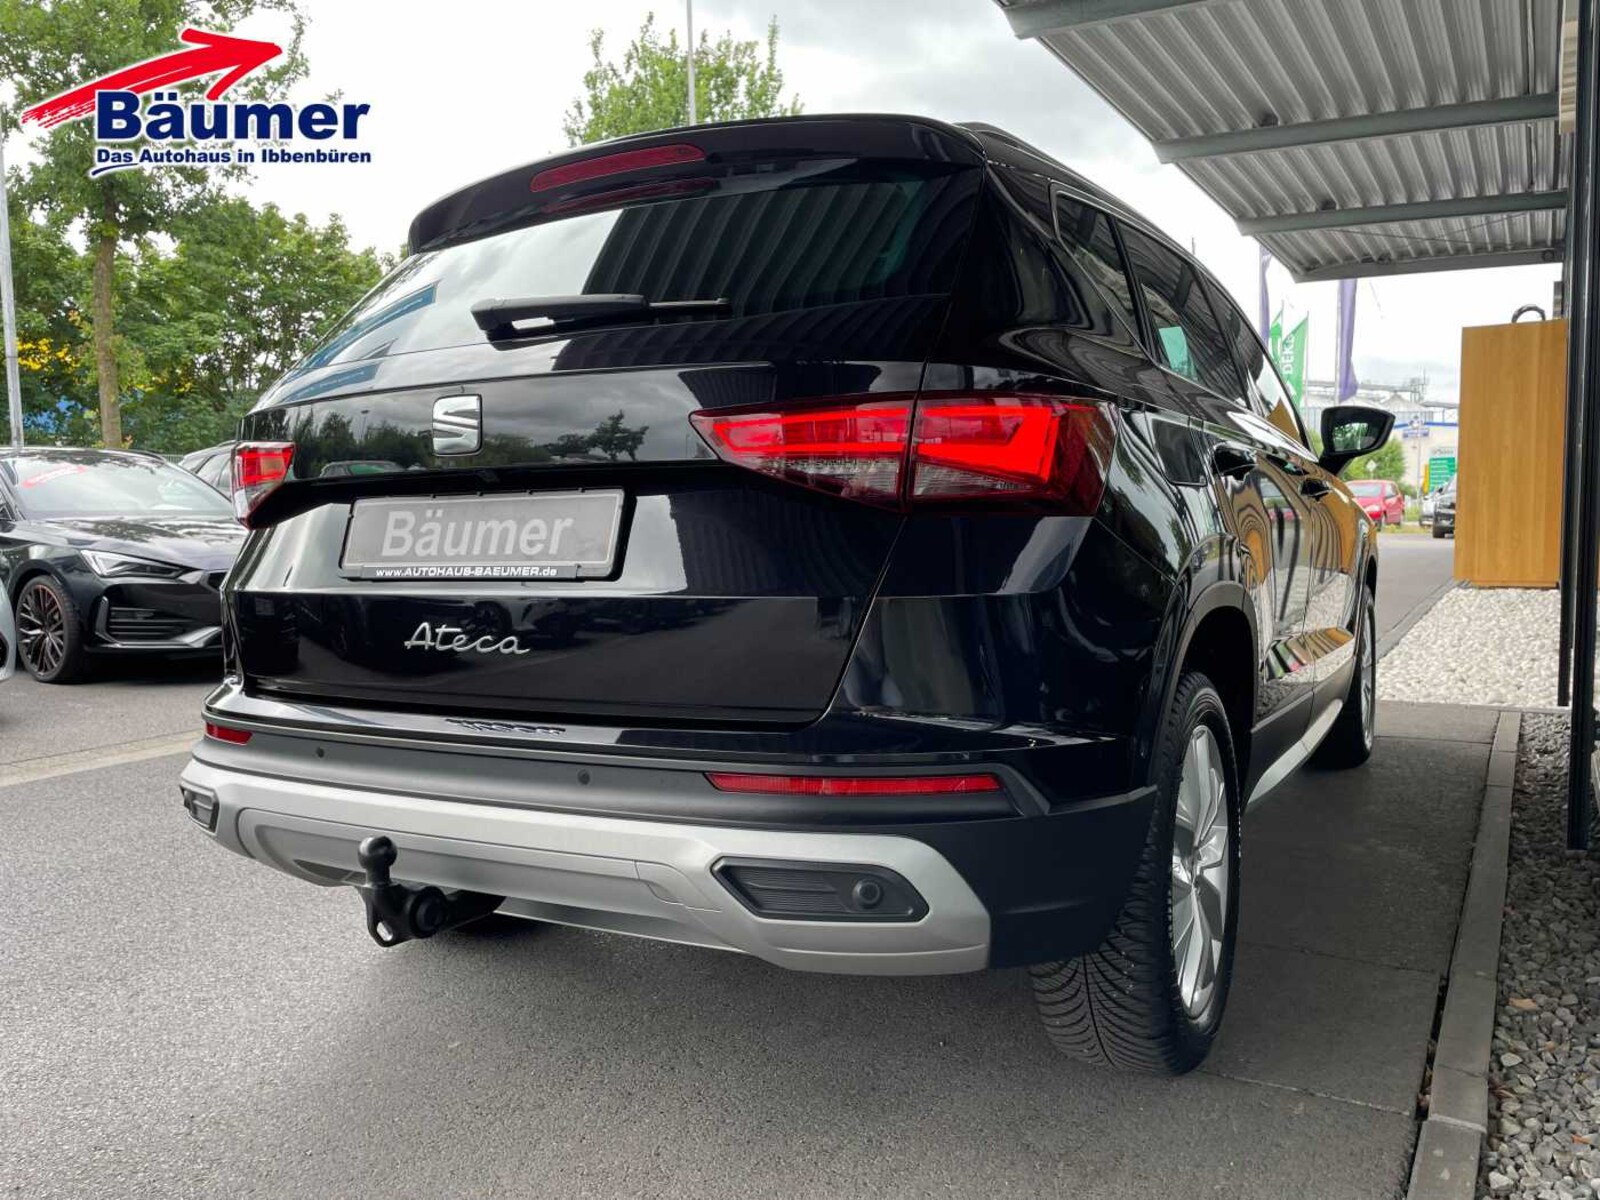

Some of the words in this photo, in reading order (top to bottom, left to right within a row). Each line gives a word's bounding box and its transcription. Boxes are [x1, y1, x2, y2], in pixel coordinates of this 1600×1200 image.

[381, 509, 575, 557] Bäumer
[375, 565, 558, 578] www.AUTOHAUS-BAEUMER.de
[404, 621, 531, 656] Ateca
